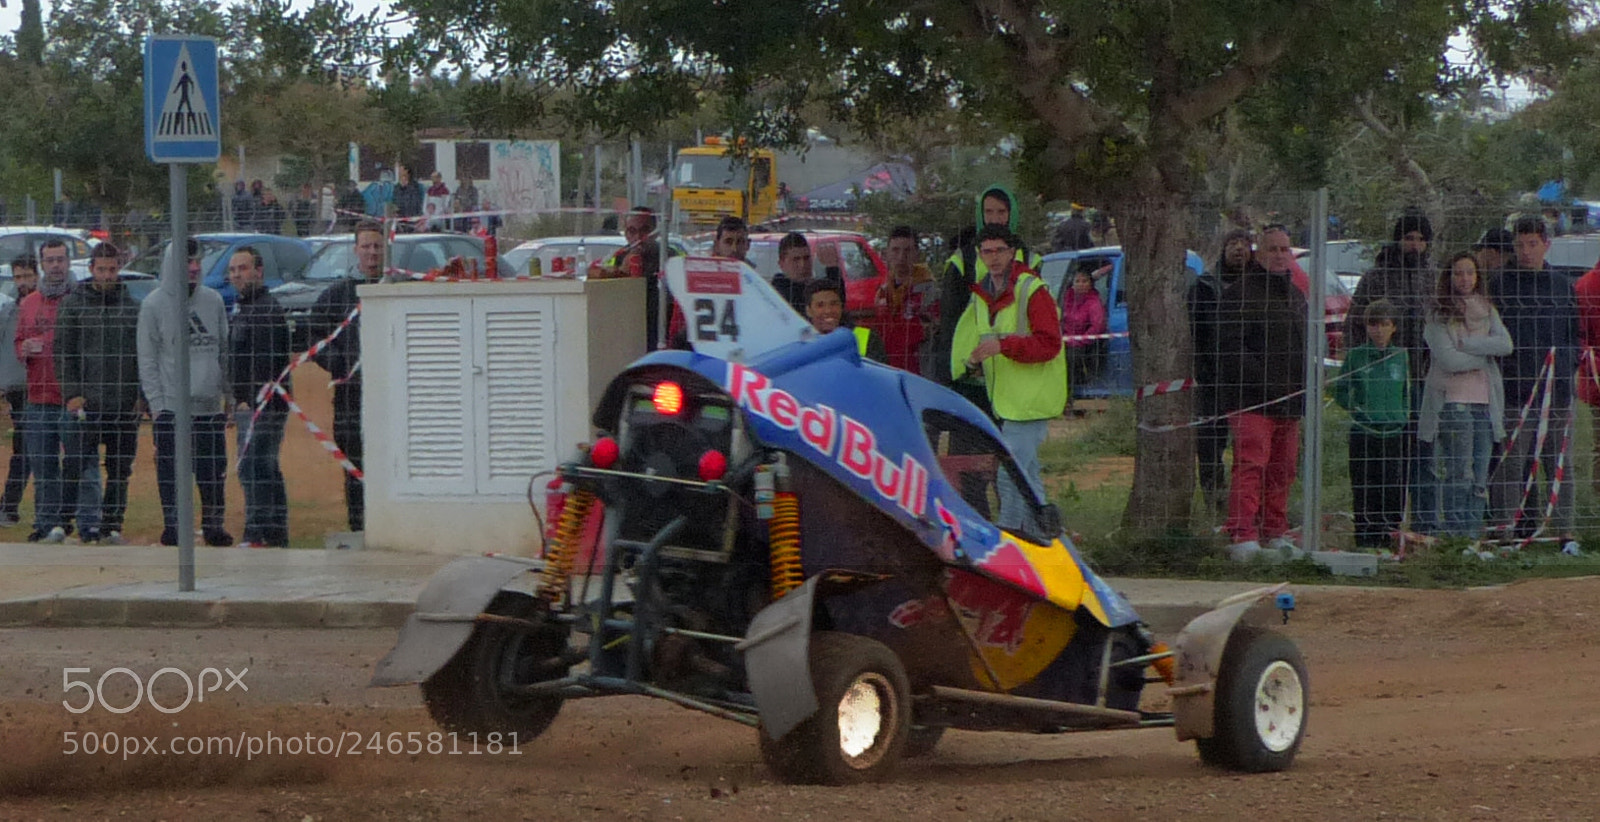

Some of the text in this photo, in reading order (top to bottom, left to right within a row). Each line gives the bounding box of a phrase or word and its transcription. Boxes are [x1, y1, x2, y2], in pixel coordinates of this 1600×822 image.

[694, 299, 740, 342] 24
[726, 362, 929, 518] Red Bull
